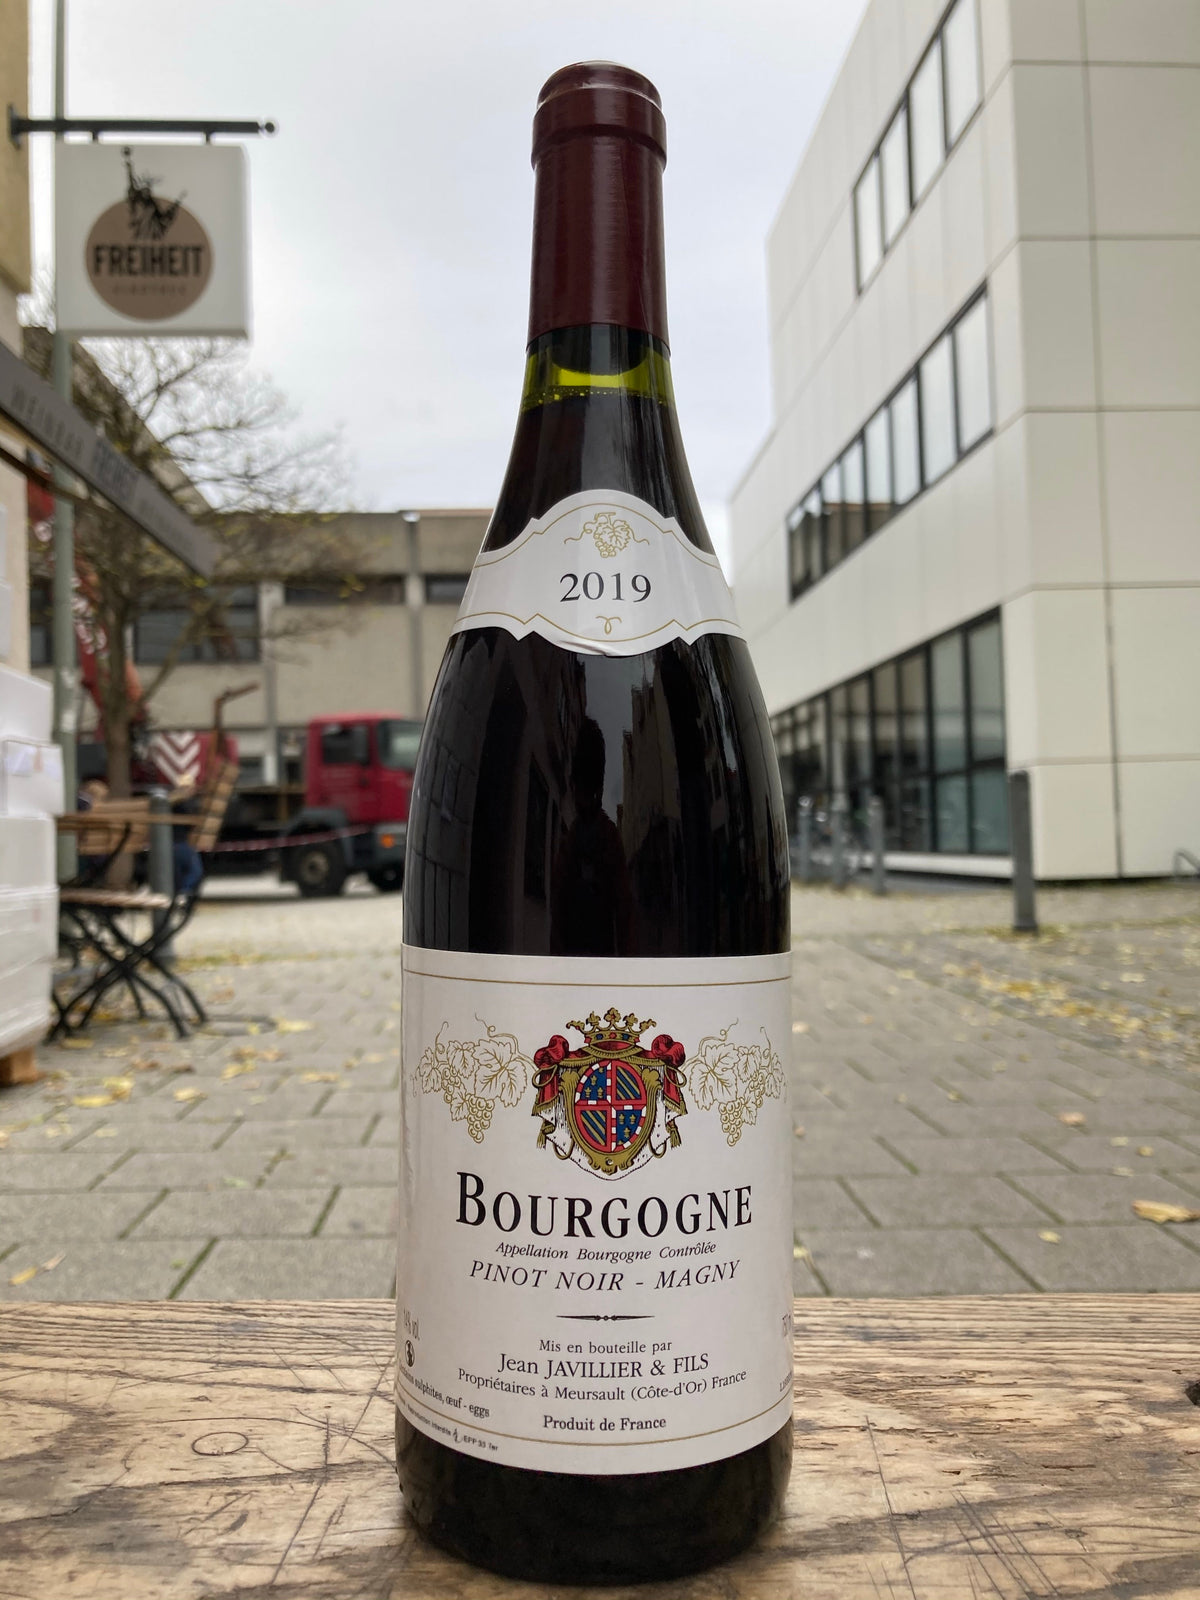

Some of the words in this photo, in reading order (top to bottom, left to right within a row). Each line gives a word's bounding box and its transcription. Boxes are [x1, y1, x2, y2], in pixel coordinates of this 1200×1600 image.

[94, 245, 203, 277] FREIHEIT
[559, 571, 652, 603] 2019
[456, 1171, 752, 1239] BOURGOGNE
[495, 1241, 569, 1260] Appellation
[576, 1247, 652, 1264] Bourgogne
[659, 1241, 717, 1259] Contrôlée
[469, 1259, 548, 1288] PINOT
[554, 1271, 624, 1291] NOIR
[653, 1259, 741, 1290] MAGNY
[538, 1339, 561, 1353] Mis
[566, 1343, 583, 1354] en
[588, 1340, 647, 1354] bouteille
[652, 1341, 673, 1356] par
[497, 1352, 539, 1375] Jean
[544, 1359, 643, 1380] JAVILLIER
[650, 1359, 666, 1377] &
[673, 1352, 709, 1374] FILS
[458, 1367, 536, 1397] Propriétaires
[541, 1384, 549, 1398] à
[555, 1386, 626, 1401] Meursault
[630, 1378, 708, 1402] (Côte-d'Or)
[711, 1370, 747, 1390] France
[445, 1395, 463, 1409] œuf
[468, 1403, 490, 1419] eggs
[543, 1414, 595, 1431] Produit
[599, 1418, 616, 1432] de
[620, 1417, 667, 1431] France
